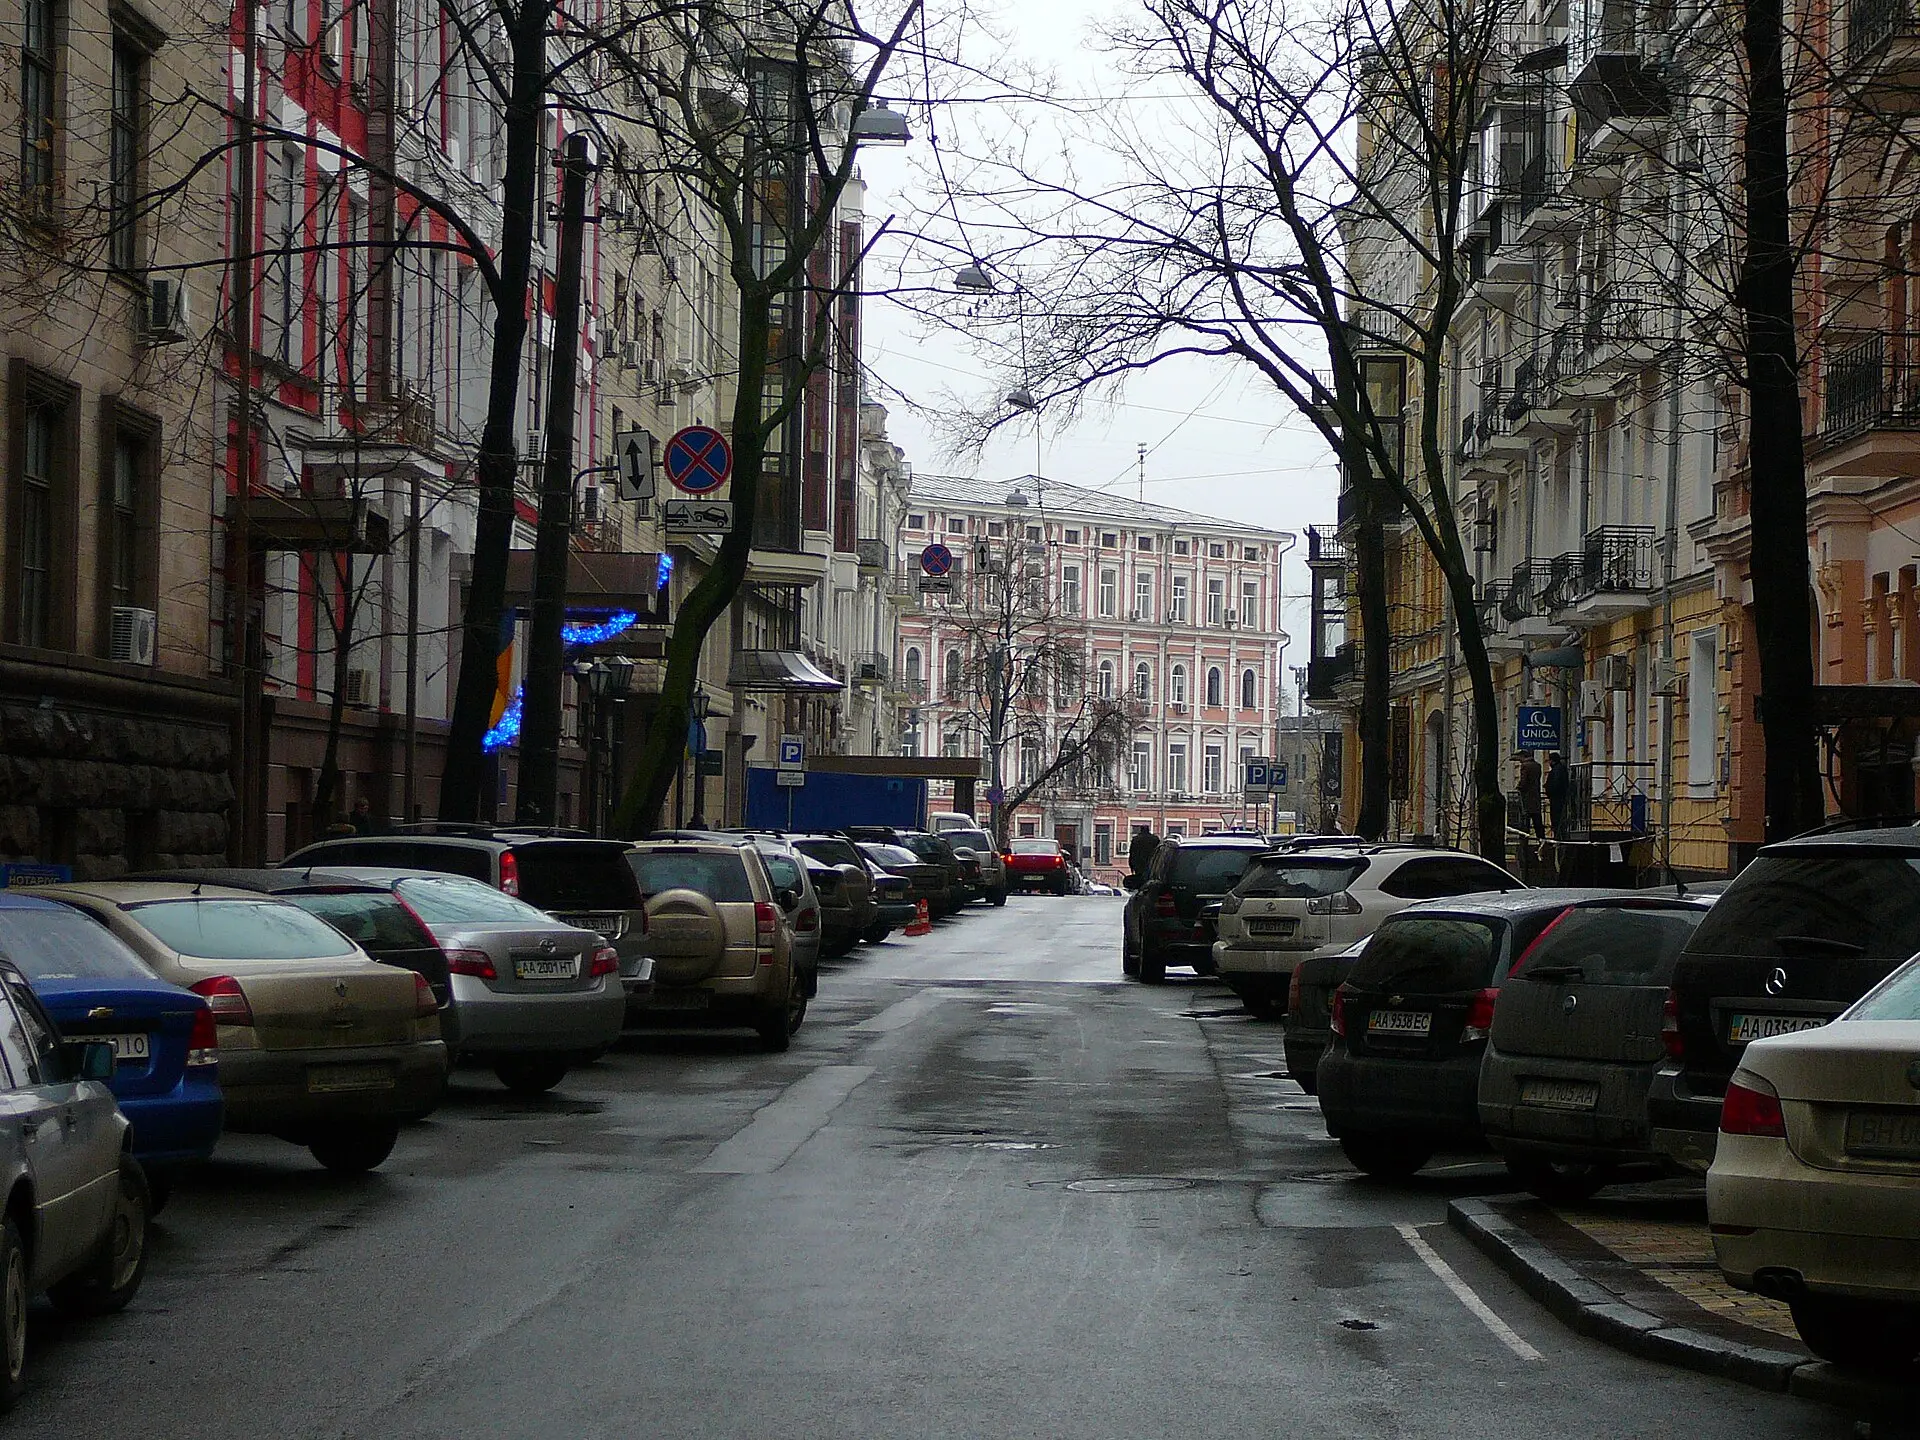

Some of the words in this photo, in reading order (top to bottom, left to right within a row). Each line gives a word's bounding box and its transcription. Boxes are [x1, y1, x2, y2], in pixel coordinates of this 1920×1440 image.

[1521, 729, 1557, 739] UNIQA
[786, 745, 799, 760] P
[1253, 767, 1264, 783] P
[522, 961, 535, 974] AA
[537, 961, 558, 974] 2001
[560, 961, 573, 973] HT
[1375, 1012, 1388, 1027] AA
[1390, 1013, 1412, 1028] 9538
[1413, 1014, 1429, 1029] EC
[1740, 1018, 1759, 1038] AA
[1764, 1019, 1797, 1037] 0351
